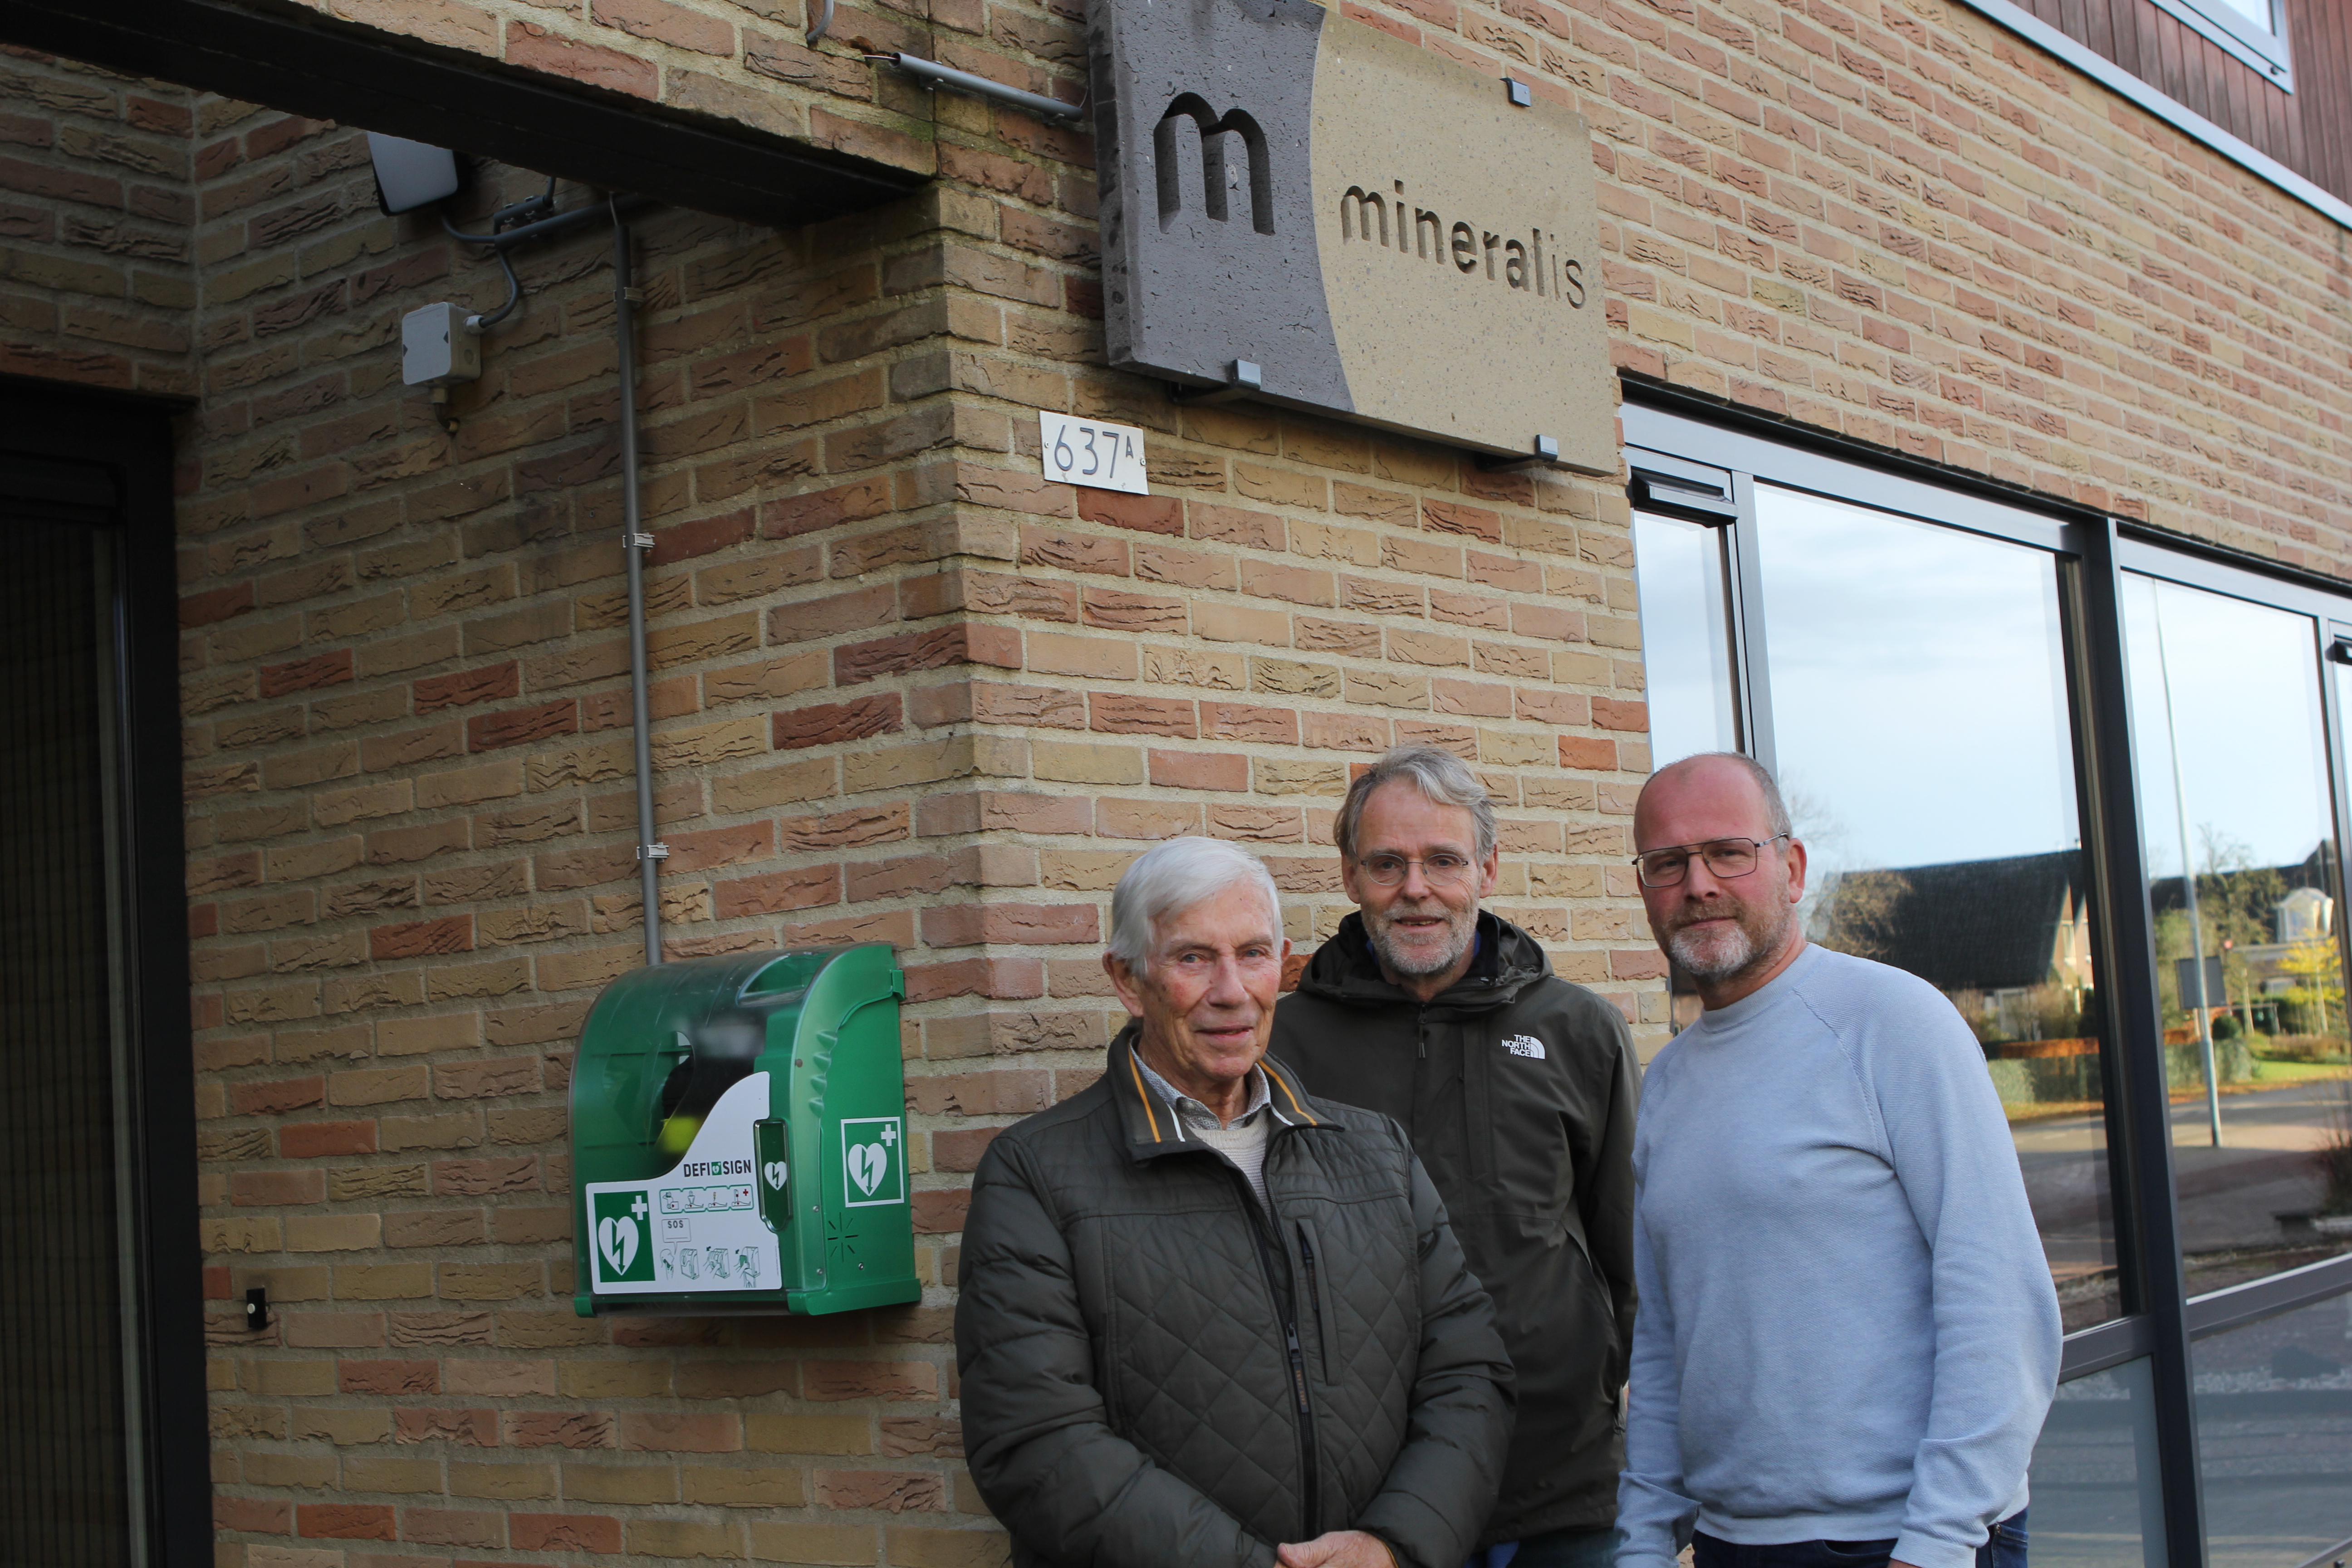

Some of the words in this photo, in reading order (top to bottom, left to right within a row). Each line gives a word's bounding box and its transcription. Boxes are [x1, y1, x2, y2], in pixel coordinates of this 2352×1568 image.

[1153, 92, 1276, 236] m
[1341, 179, 1586, 309] mineralis
[1514, 1034, 1530, 1043] THE
[1501, 1039, 1530, 1050] NORTH
[1510, 1047, 1530, 1057] FACE
[667, 1220, 684, 1229] SOS
